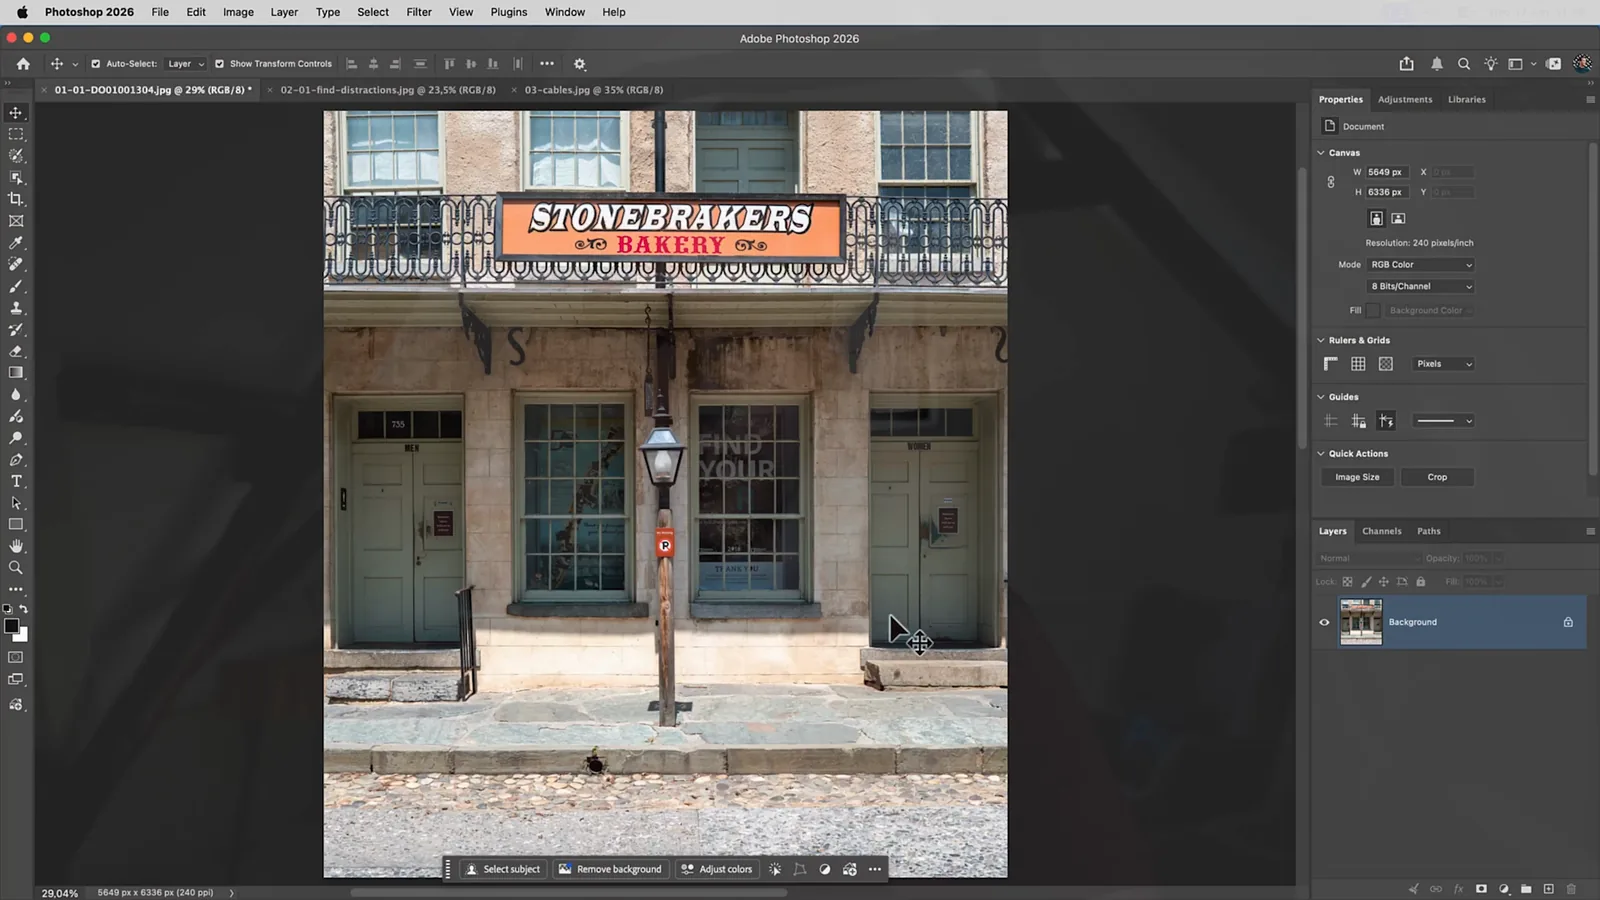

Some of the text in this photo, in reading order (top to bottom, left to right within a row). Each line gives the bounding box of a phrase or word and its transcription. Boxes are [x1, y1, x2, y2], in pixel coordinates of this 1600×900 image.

[46, 6, 134, 18] Photoshop 2026
[152, 6, 170, 16] File
[186, 6, 206, 16] Edit
[224, 8, 254, 18] Image
[270, 8, 298, 18] Layer
[316, 8, 340, 18] Type
[358, 8, 390, 16] Select
[406, 6, 432, 16] Filter
[448, 6, 474, 16] View
[490, 6, 528, 18] Plugins
[544, 6, 586, 16] Window
[602, 8, 626, 18] Help
[740, 34, 860, 46] Adobe Photoshop 2026
[106, 60, 158, 68] Auto-Select:
[168, 60, 192, 70] Layer
[230, 60, 332, 68] Show Transform Controls
[174, 86, 184, 96] @
[186, 86, 206, 94] 29%
[208, 86, 246, 96] (RGB/8)
[280, 86, 496, 96] 02-01-find-distractions.jpg @ 23,5% (RGB/8)
[524, 86, 664, 96] 03-cables.jpg @ 35% (RGB/8)
[1320, 96, 1364, 104] Properties
[1378, 96, 1432, 104] Adjustments
[1448, 96, 1486, 104] Libraries
[1344, 122, 1384, 130] Document
[1328, 148, 1360, 156] Canvas
[1392, 170, 1402, 178] px
[1368, 188, 1390, 196] 6336
[528, 201, 814, 235] STONEBRAKERS
[616, 235, 726, 255] BAKERY
[1366, 238, 1474, 248] Resolution: 240 pixels/inch
[1338, 260, 1362, 268] Mode
[1372, 260, 1414, 268] RGB Color
[1372, 282, 1430, 292] 8 Bits/Channel
[1350, 306, 1362, 314] Fill
[1390, 306, 1462, 316] Background Color
[1328, 336, 1390, 344] Rulers & Grids
[1418, 360, 1442, 368] Pixels
[1328, 392, 1360, 400] Guides
[405, 444, 419, 452] MEN
[700, 433, 762, 455] FIND
[1328, 450, 1388, 458] Quick Actions
[700, 460, 774, 481] YOUR
[1336, 472, 1380, 482] Image Size
[1428, 472, 1448, 482] Crop
[1320, 528, 1348, 536] Layers
[1362, 526, 1402, 536] Channels
[1418, 526, 1442, 536] Paths
[1320, 554, 1350, 562] Normal
[1426, 554, 1460, 564] Opacity:
[1316, 578, 1336, 586] Lock:
[1446, 578, 1460, 586] Fill:
[1388, 618, 1438, 628] Background
[484, 864, 540, 876] Select subject
[578, 864, 662, 876] Remove background
[700, 864, 752, 876] Adjust colors
[98, 888, 120, 896] 5649
[122, 890, 132, 898] px
[140, 888, 162, 896] 6336
[164, 890, 174, 898] px
[176, 888, 196, 898] (240
[198, 888, 214, 898] ppi)
